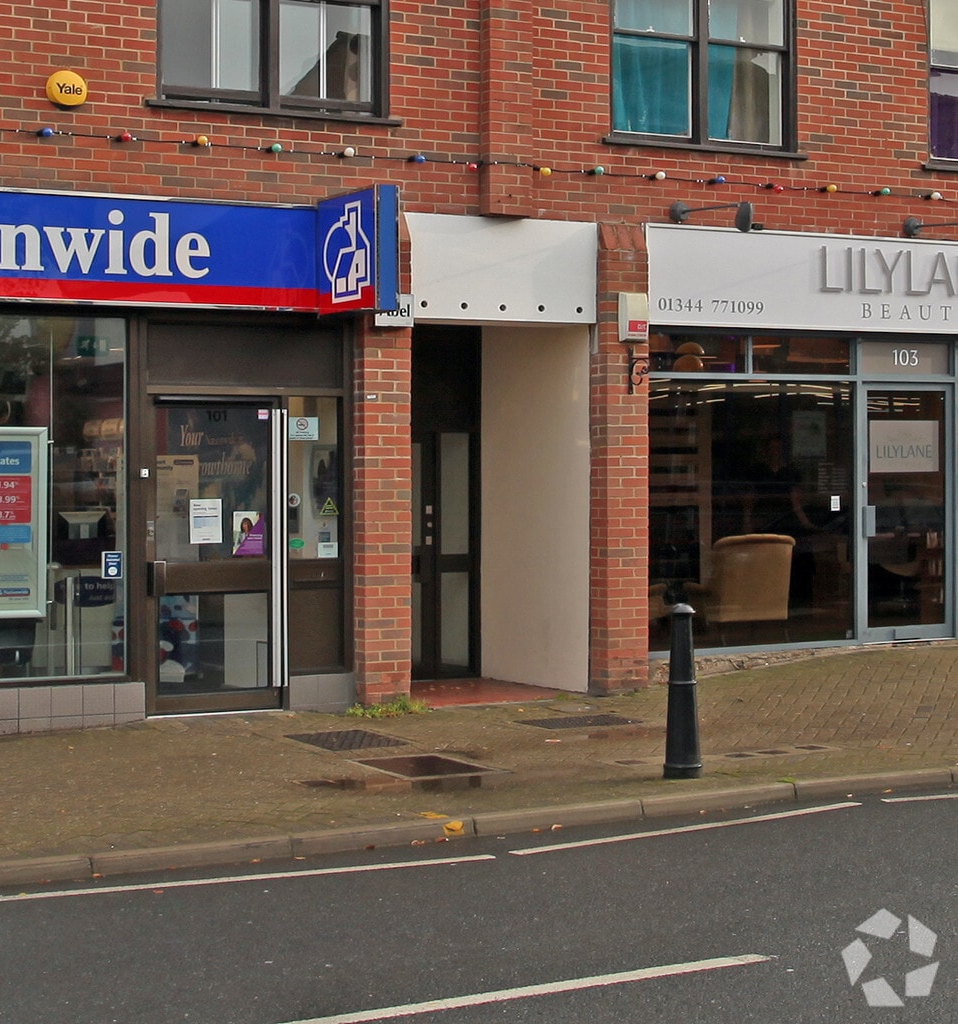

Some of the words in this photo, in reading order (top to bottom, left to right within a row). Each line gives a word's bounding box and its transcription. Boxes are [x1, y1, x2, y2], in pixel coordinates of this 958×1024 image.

[56, 82, 83, 95] Yale
[658, 297, 703, 312] 01344
[711, 299, 764, 315] 771099
[861, 302, 952, 321] BEAUT
[892, 349, 919, 366] 103
[206, 410, 228, 422] 101
[180, 424, 204, 447] Your
[875, 444, 932, 459] LILYLANE
